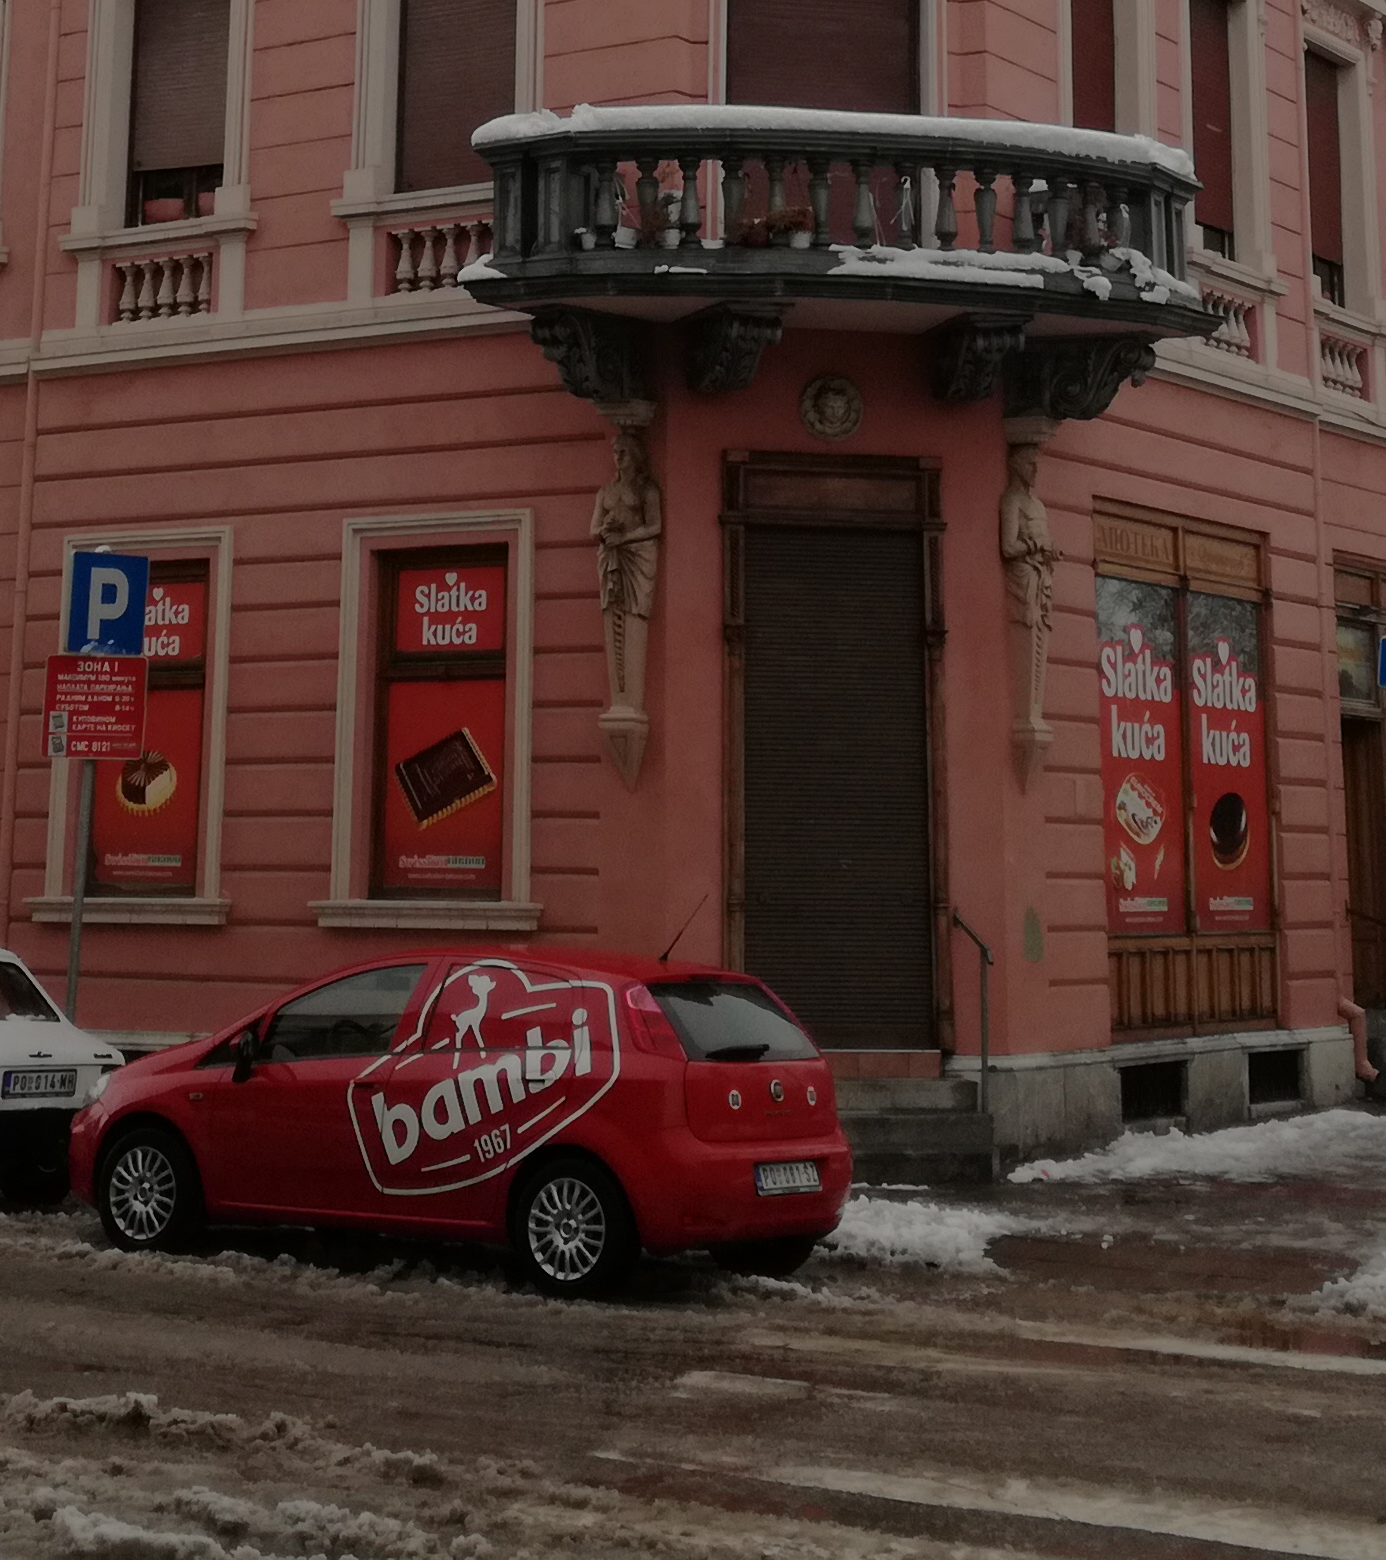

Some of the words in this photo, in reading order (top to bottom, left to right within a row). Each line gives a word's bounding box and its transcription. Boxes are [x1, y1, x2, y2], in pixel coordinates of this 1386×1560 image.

[87, 567, 129, 640] P
[145, 597, 189, 625] atka
[415, 582, 487, 613] Slatka
[144, 629, 180, 656] uća
[422, 616, 477, 645] kuća
[77, 661, 110, 672] ЗОНА
[1101, 645, 1173, 703] Slatka
[1192, 657, 1257, 712] Slatka
[1111, 704, 1165, 761] kuća
[1201, 713, 1250, 768] kuća
[13, 1075, 27, 1091] PO
[371, 1008, 591, 1165] bambi
[473, 1123, 511, 1163] 1967
